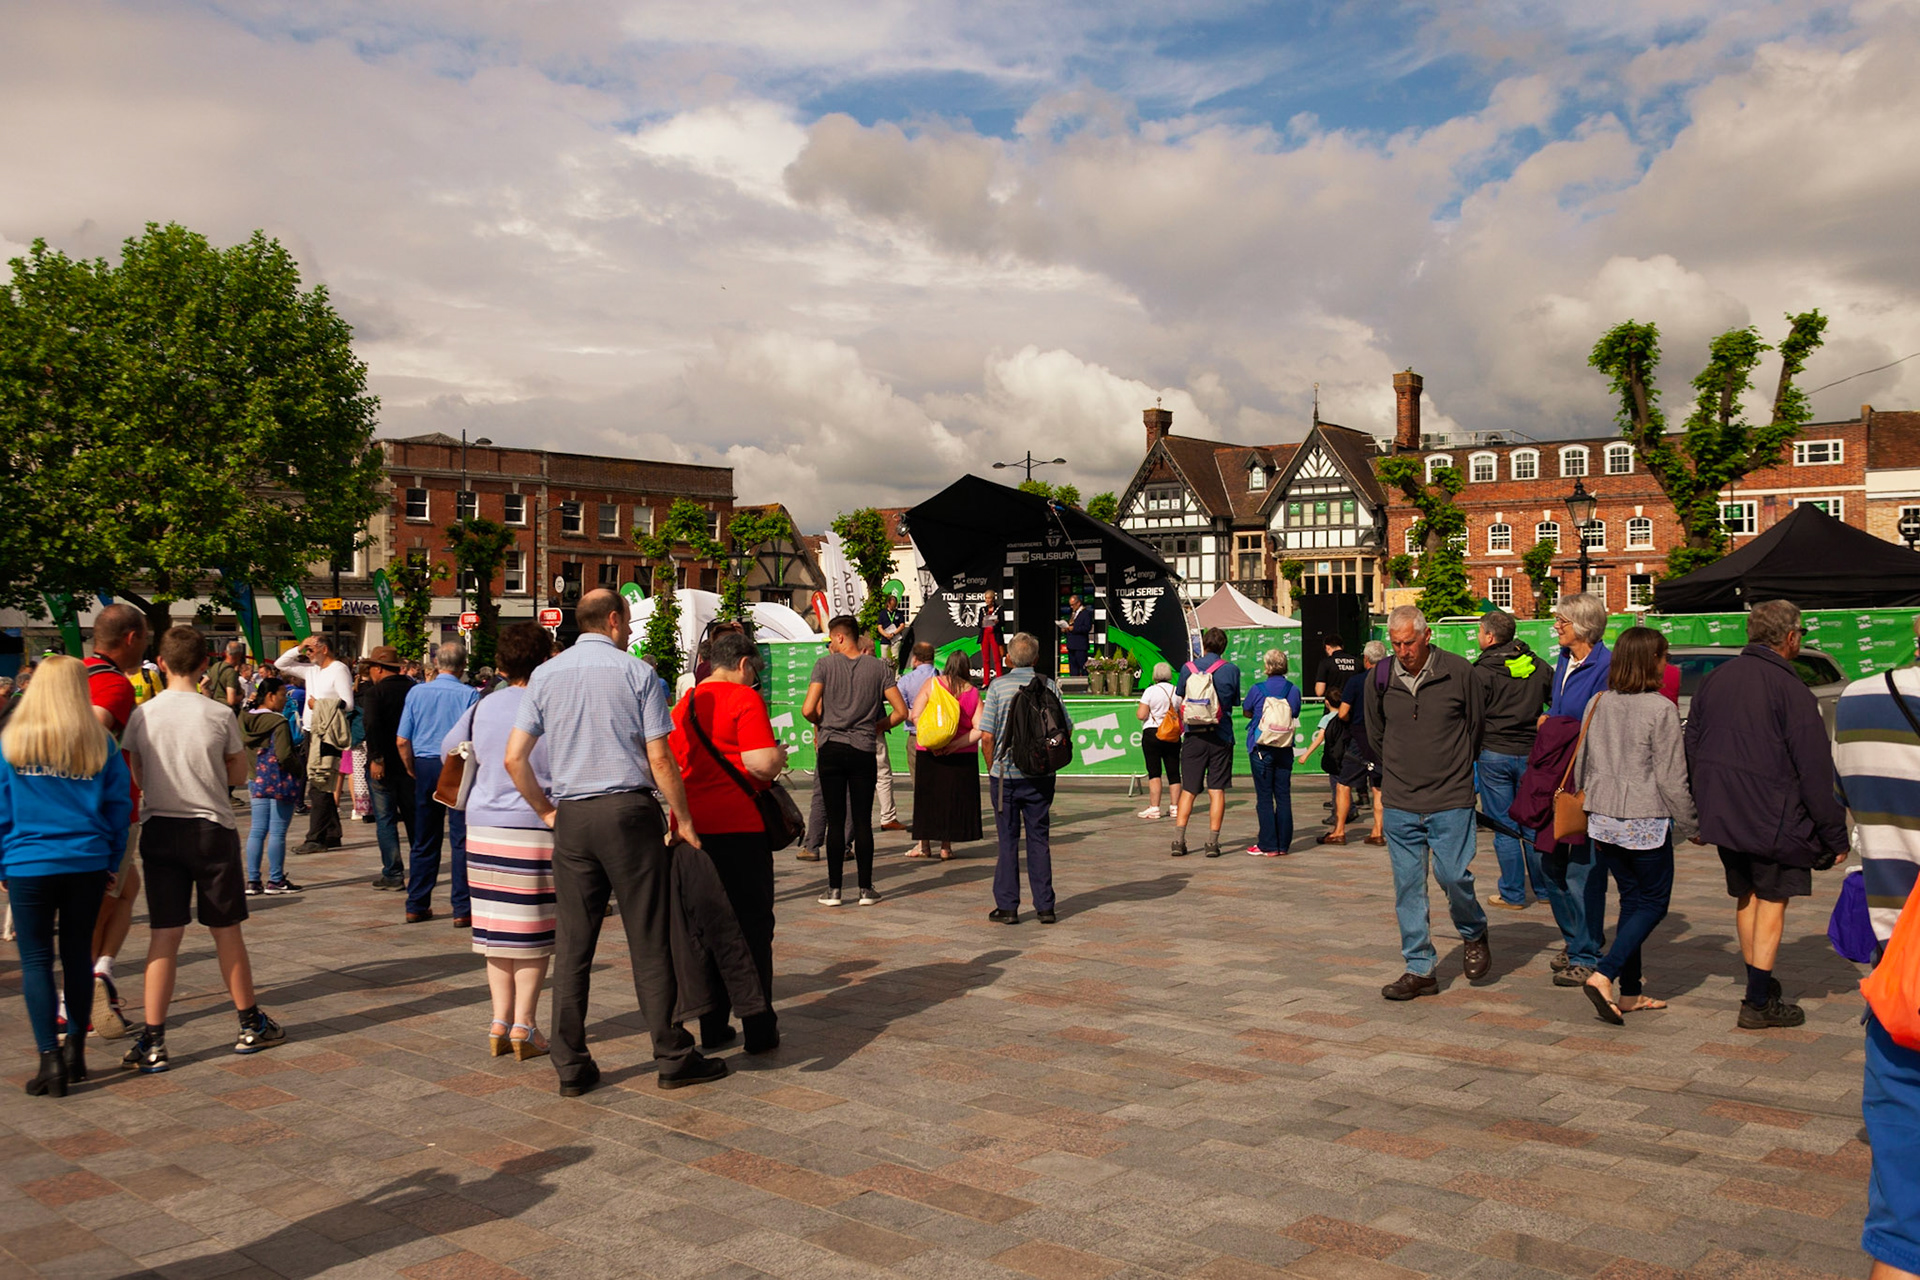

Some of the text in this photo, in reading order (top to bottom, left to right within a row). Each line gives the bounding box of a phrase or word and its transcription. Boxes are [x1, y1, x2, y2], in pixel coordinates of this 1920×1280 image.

[1031, 551, 1075, 561] SALISBURY
[1137, 571, 1156, 580] energy
[966, 577, 988, 586] energy
[1115, 586, 1165, 597] TOUR SERIES
[941, 592, 964, 601] TOUR
[289, 601, 305, 628] energy
